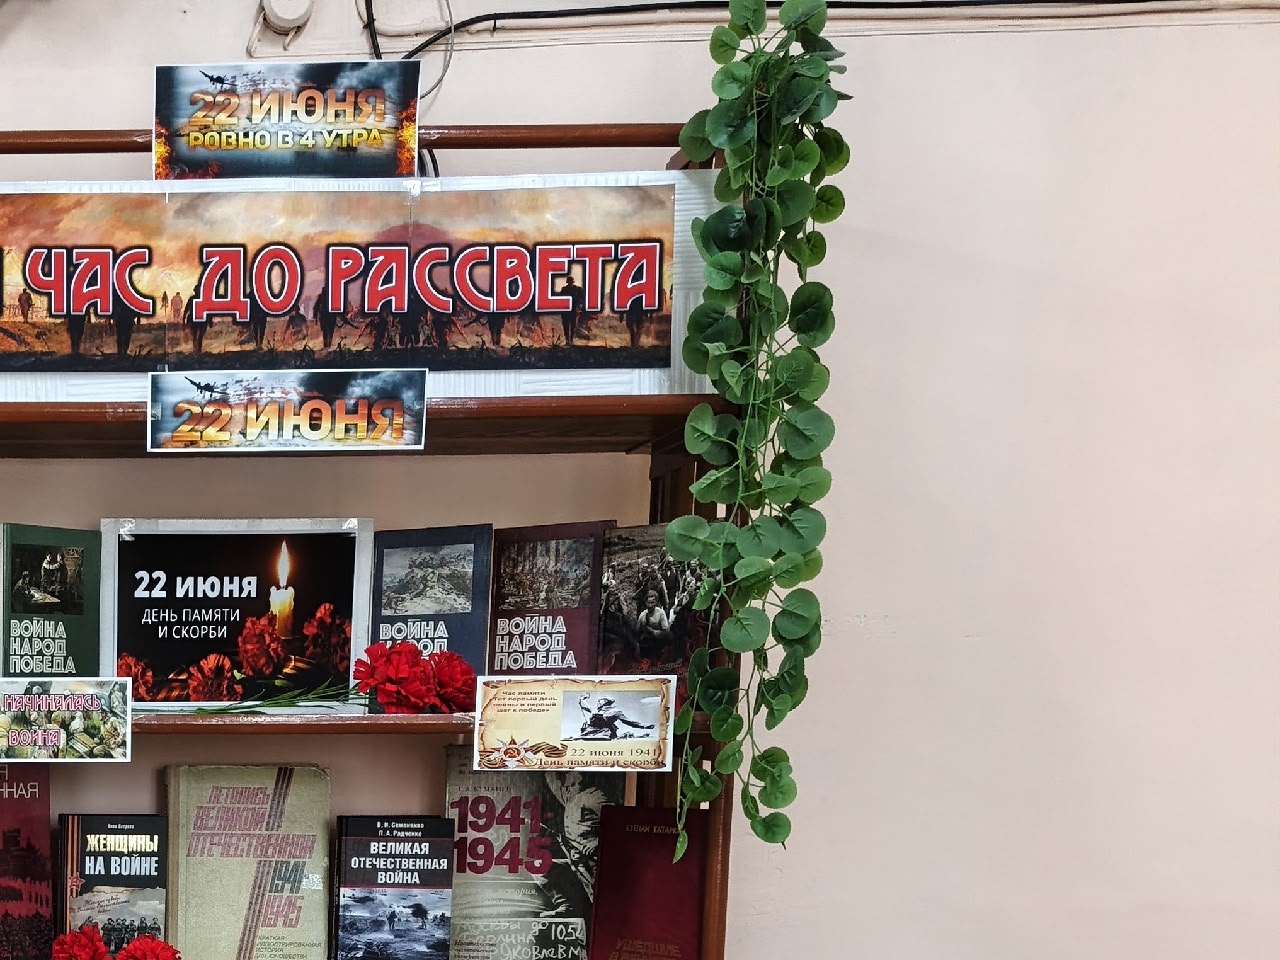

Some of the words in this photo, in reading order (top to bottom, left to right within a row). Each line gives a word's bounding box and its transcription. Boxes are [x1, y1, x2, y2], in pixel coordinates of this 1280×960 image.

[189, 91, 239, 126] 22
[251, 89, 385, 124] ИЮНЯ
[189, 132, 270, 149] РОВНО
[278, 133, 293, 148] В
[300, 132, 315, 148] 4
[324, 129, 384, 148] УТРА
[26, 249, 152, 314] ЧАС
[194, 247, 301, 321] ДО
[328, 242, 660, 314] РАССВЕТА
[172, 401, 232, 440] 22
[246, 399, 404, 440] ИЮНЯ
[134, 571, 166, 598] 22
[176, 576, 257, 598] июня
[142, 608, 178, 624] ДЕНЬ
[182, 608, 240, 622] ПАМЯТИ
[497, 614, 566, 635] ВОЙНА
[11, 617, 66, 638] ВОЙНА
[158, 626, 168, 638] И
[173, 626, 227, 638] СКОРБИ
[380, 619, 448, 639] ВОЙНА
[10, 638, 66, 656] НАРОД
[496, 634, 566, 651] НАРОД
[9, 657, 76, 673] ПОБЕДА
[494, 651, 577, 670] ПОБЕДА
[4, 694, 101, 712] НАЧИНАЛАСЬ
[9, 726, 61, 747] ВОЙНА
[590, 749, 624, 757] июня
[630, 748, 657, 756] 1941
[86, 834, 158, 852] ЖЕНЩИНЫ
[370, 842, 429, 855] ВЕЛИКАЯ
[86, 856, 106, 875] НА
[111, 854, 158, 876] ВОЙНЕ
[351, 857, 448, 870] ОТЕЧЕСТВЕННАЯ
[453, 836, 553, 875] 1945
[270, 860, 306, 894] 1941
[377, 870, 420, 884] ВОЙНА
